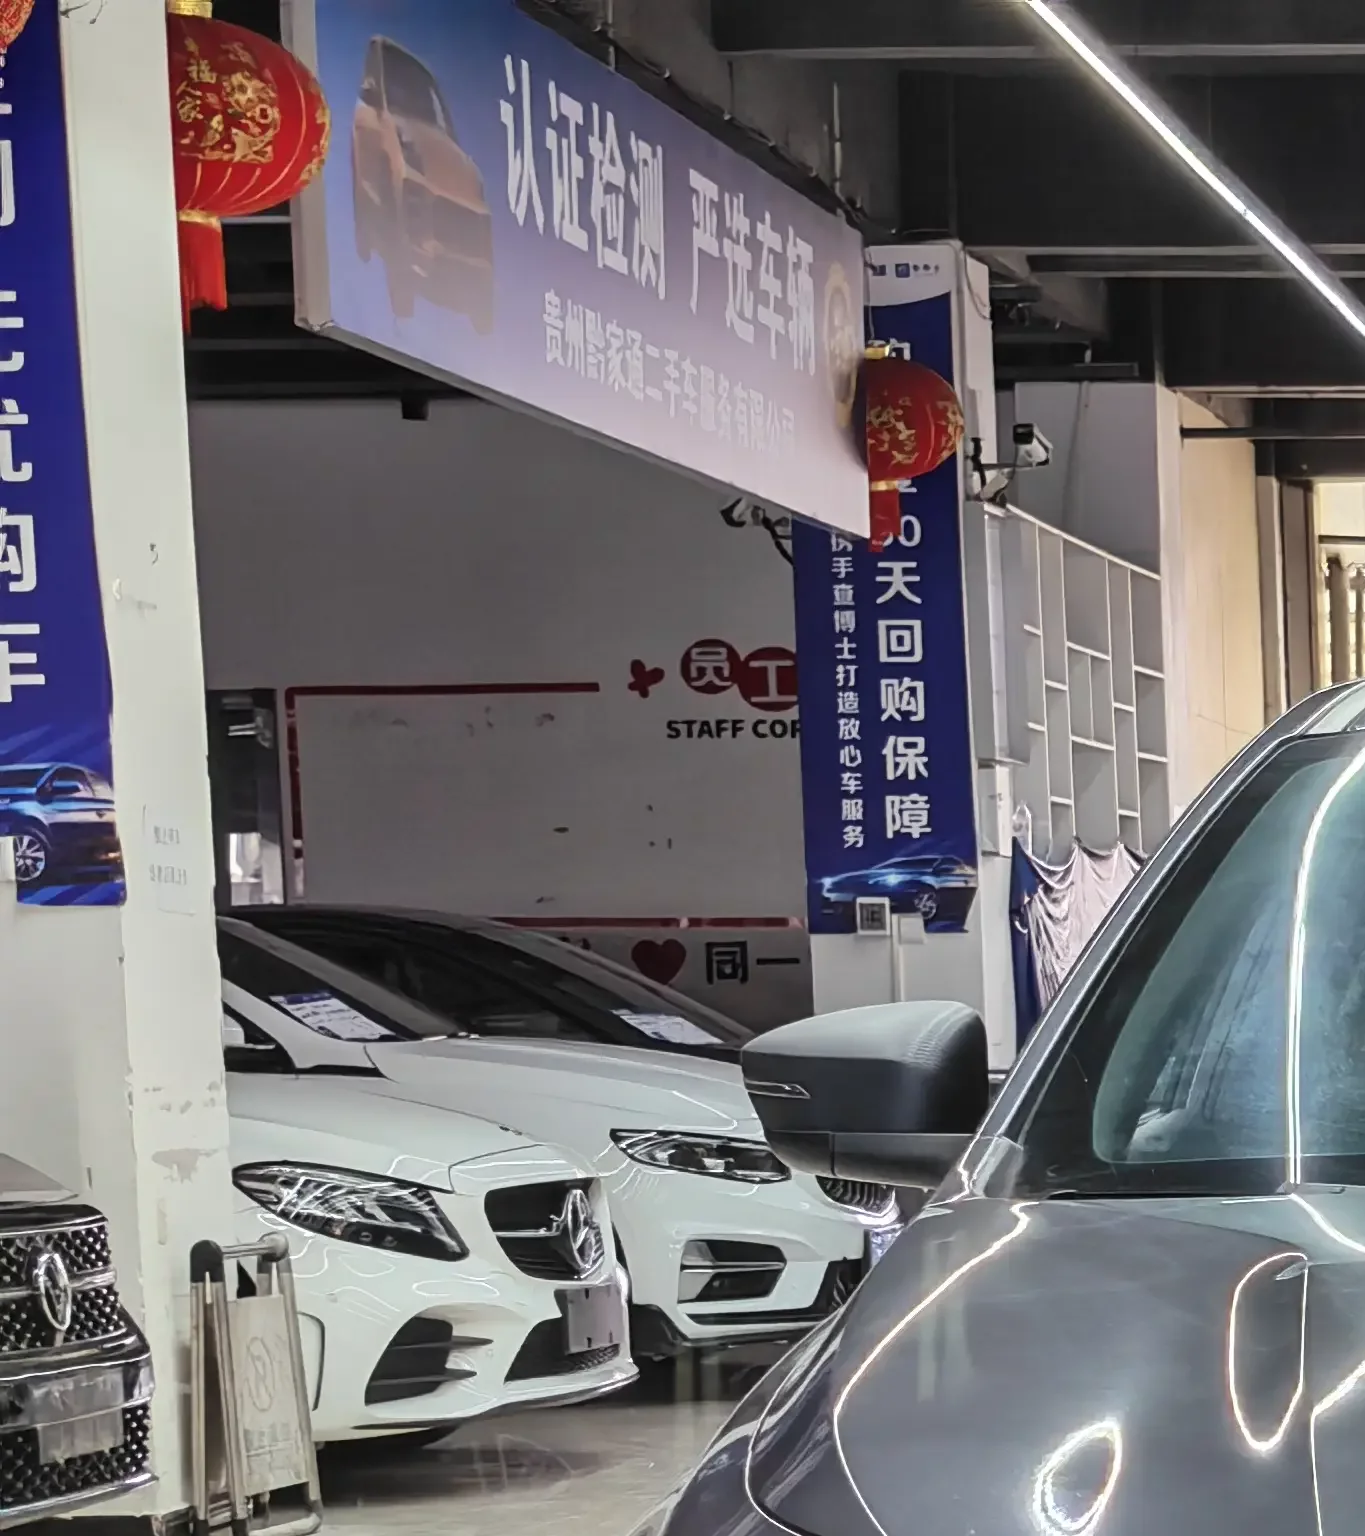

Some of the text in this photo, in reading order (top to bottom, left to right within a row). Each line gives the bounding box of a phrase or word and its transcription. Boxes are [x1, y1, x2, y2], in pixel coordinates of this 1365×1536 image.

[499, 53, 816, 377] 认证检测 严选车辆
[689, 647, 798, 703] 员工
[874, 513, 933, 840] 0天回购保障
[666, 718, 746, 739] STAFF
[704, 940, 801, 985] 同一
